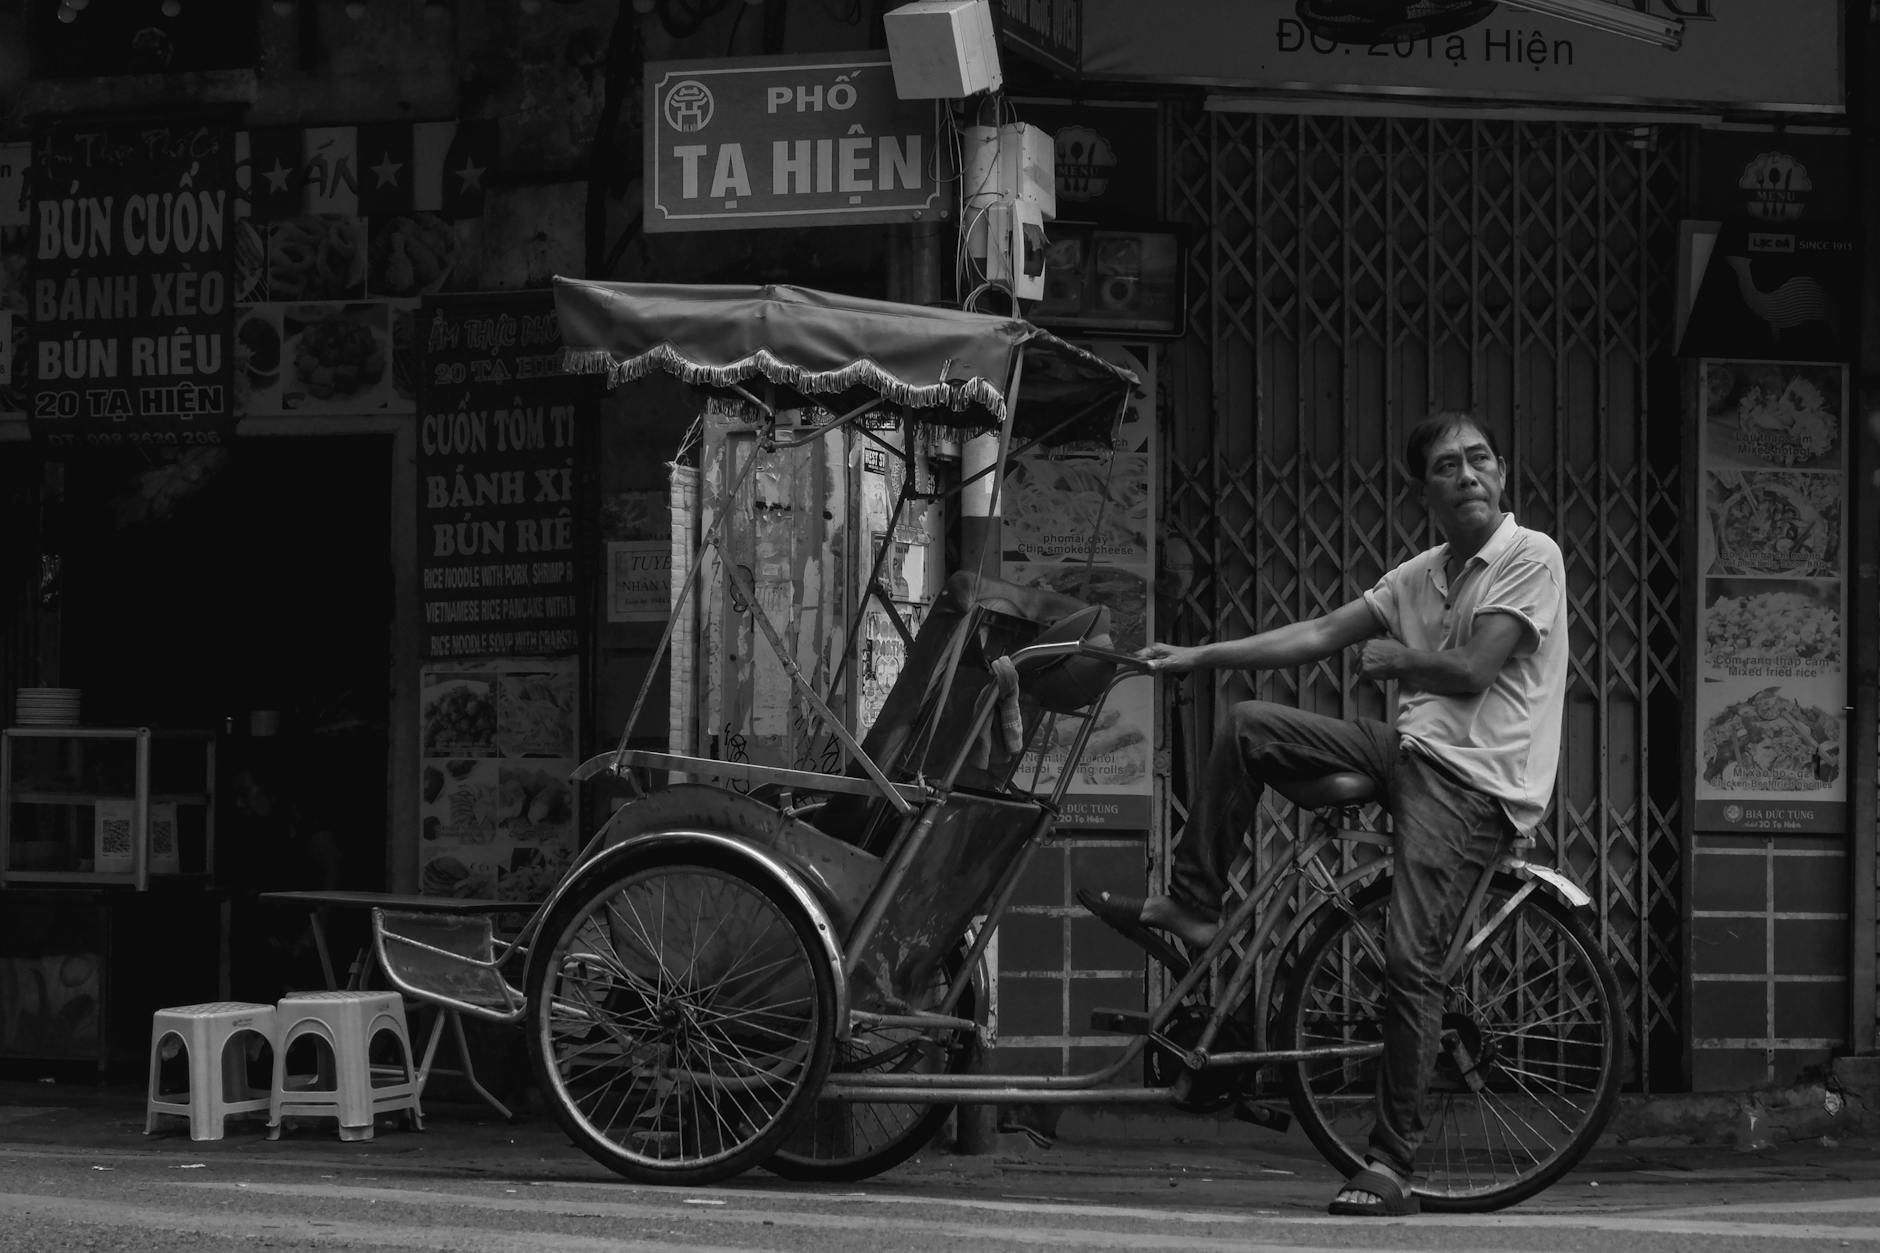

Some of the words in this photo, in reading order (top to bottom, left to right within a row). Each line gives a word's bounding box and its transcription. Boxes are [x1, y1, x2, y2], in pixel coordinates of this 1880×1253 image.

[1485, 28, 1574, 72] Hiện
[767, 70, 862, 114] PHỐ
[673, 142, 752, 210] TẠ
[772, 123, 922, 204] HIỆN
[38, 179, 114, 260] BÚN
[122, 160, 226, 256] CUỐN
[1757, 191, 1796, 201] MENU
[1799, 240, 1831, 251] SINCE
[34, 267, 138, 322] BÁNH
[149, 263, 225, 317] XÈO
[38, 330, 118, 380] BÚN
[131, 326, 221, 378] RIÊU
[434, 361, 467, 385] 20
[470, 357, 513, 386] TẠ
[34, 391, 80, 419] 20
[85, 388, 134, 421] TẠ
[140, 381, 225, 420] HIỆN
[422, 391, 488, 456] CUỐN
[493, 395, 546, 452] TÔM
[426, 462, 526, 509] BÁNH
[432, 511, 506, 557] BÚN
[1046, 543, 1092, 555] smoked
[1094, 544, 1134, 556] cheese
[423, 568, 443, 590] RICE
[444, 566, 480, 588] NOODLE
[481, 565, 503, 587] WITH
[531, 561, 565, 585] SHRIMP
[425, 600, 480, 623] VIETNAMESE
[481, 599, 500, 621] RICE
[501, 597, 545, 620] PANCAKE
[546, 596, 568, 618] WITH
[430, 635, 450, 656] RICE
[450, 633, 487, 656] NOODLE
[488, 632, 513, 654] SOUP
[514, 631, 538, 653] WITH
[1728, 666, 1762, 678] Mixed
[1765, 666, 1793, 678] fried
[1795, 667, 1818, 678] rice
[1098, 765, 1124, 775] rolls
[1058, 814, 1073, 823] 20
[1745, 809, 1763, 820] BIA
[1759, 820, 1771, 829] 20
